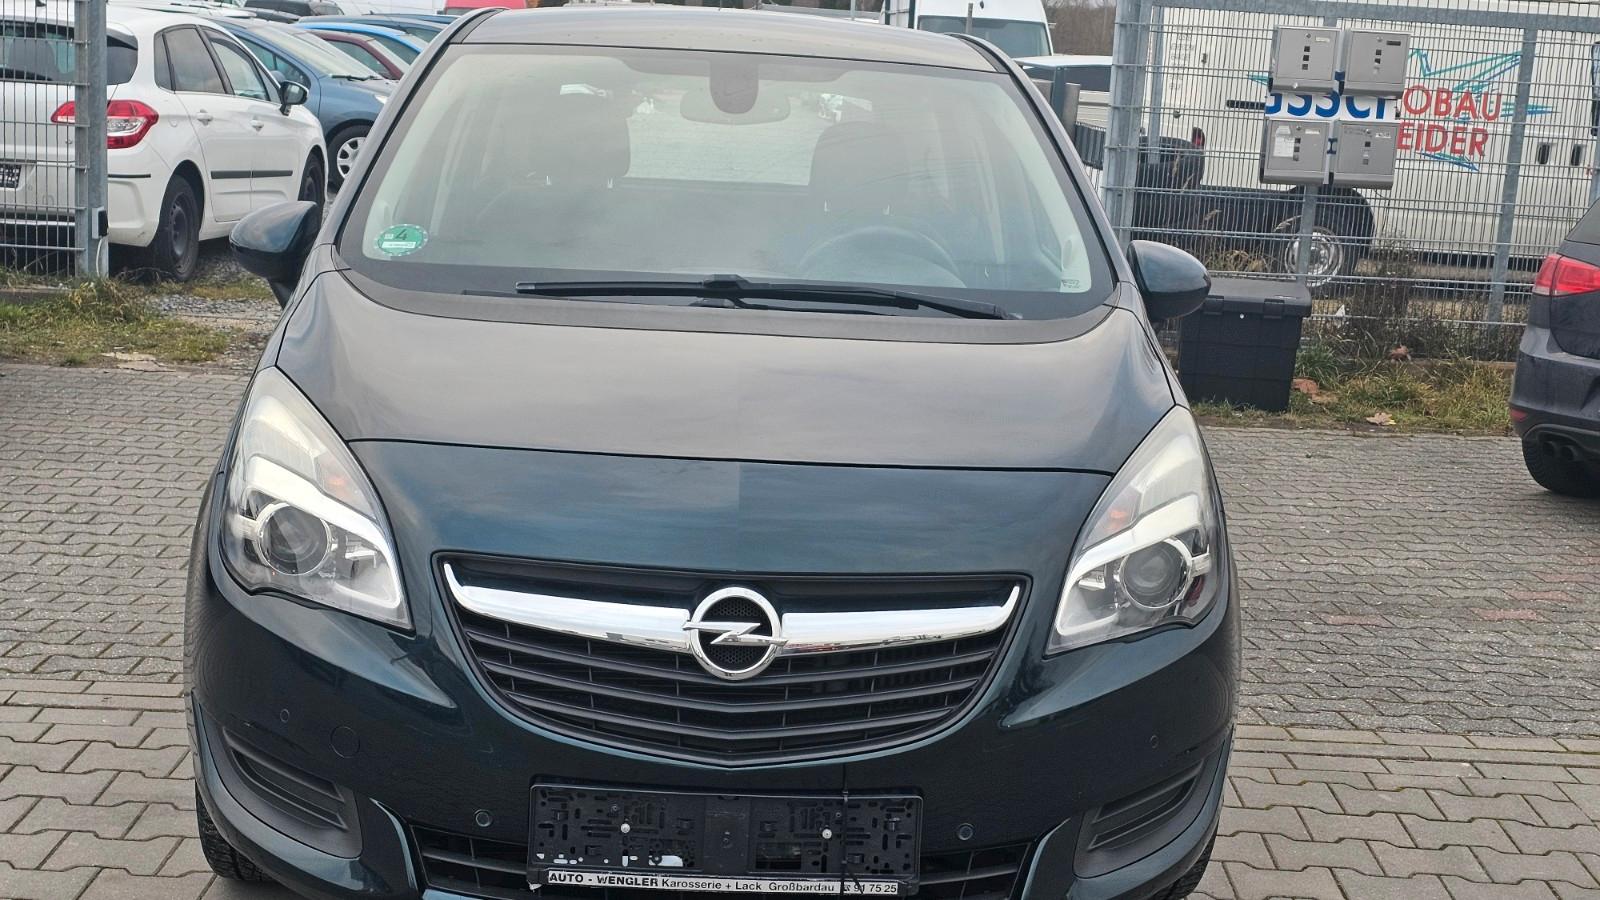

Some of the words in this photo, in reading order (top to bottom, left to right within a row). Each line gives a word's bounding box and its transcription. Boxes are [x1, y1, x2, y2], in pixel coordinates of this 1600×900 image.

[395, 228, 408, 241] 4
[549, 872, 584, 883] AUTO
[597, 875, 659, 887] WENGLER
[661, 878, 722, 890] Karosserie
[735, 881, 762, 891] Lack
[768, 881, 835, 892] Großbardau
[869, 883, 883, 893] 75
[884, 884, 898, 894] 25
